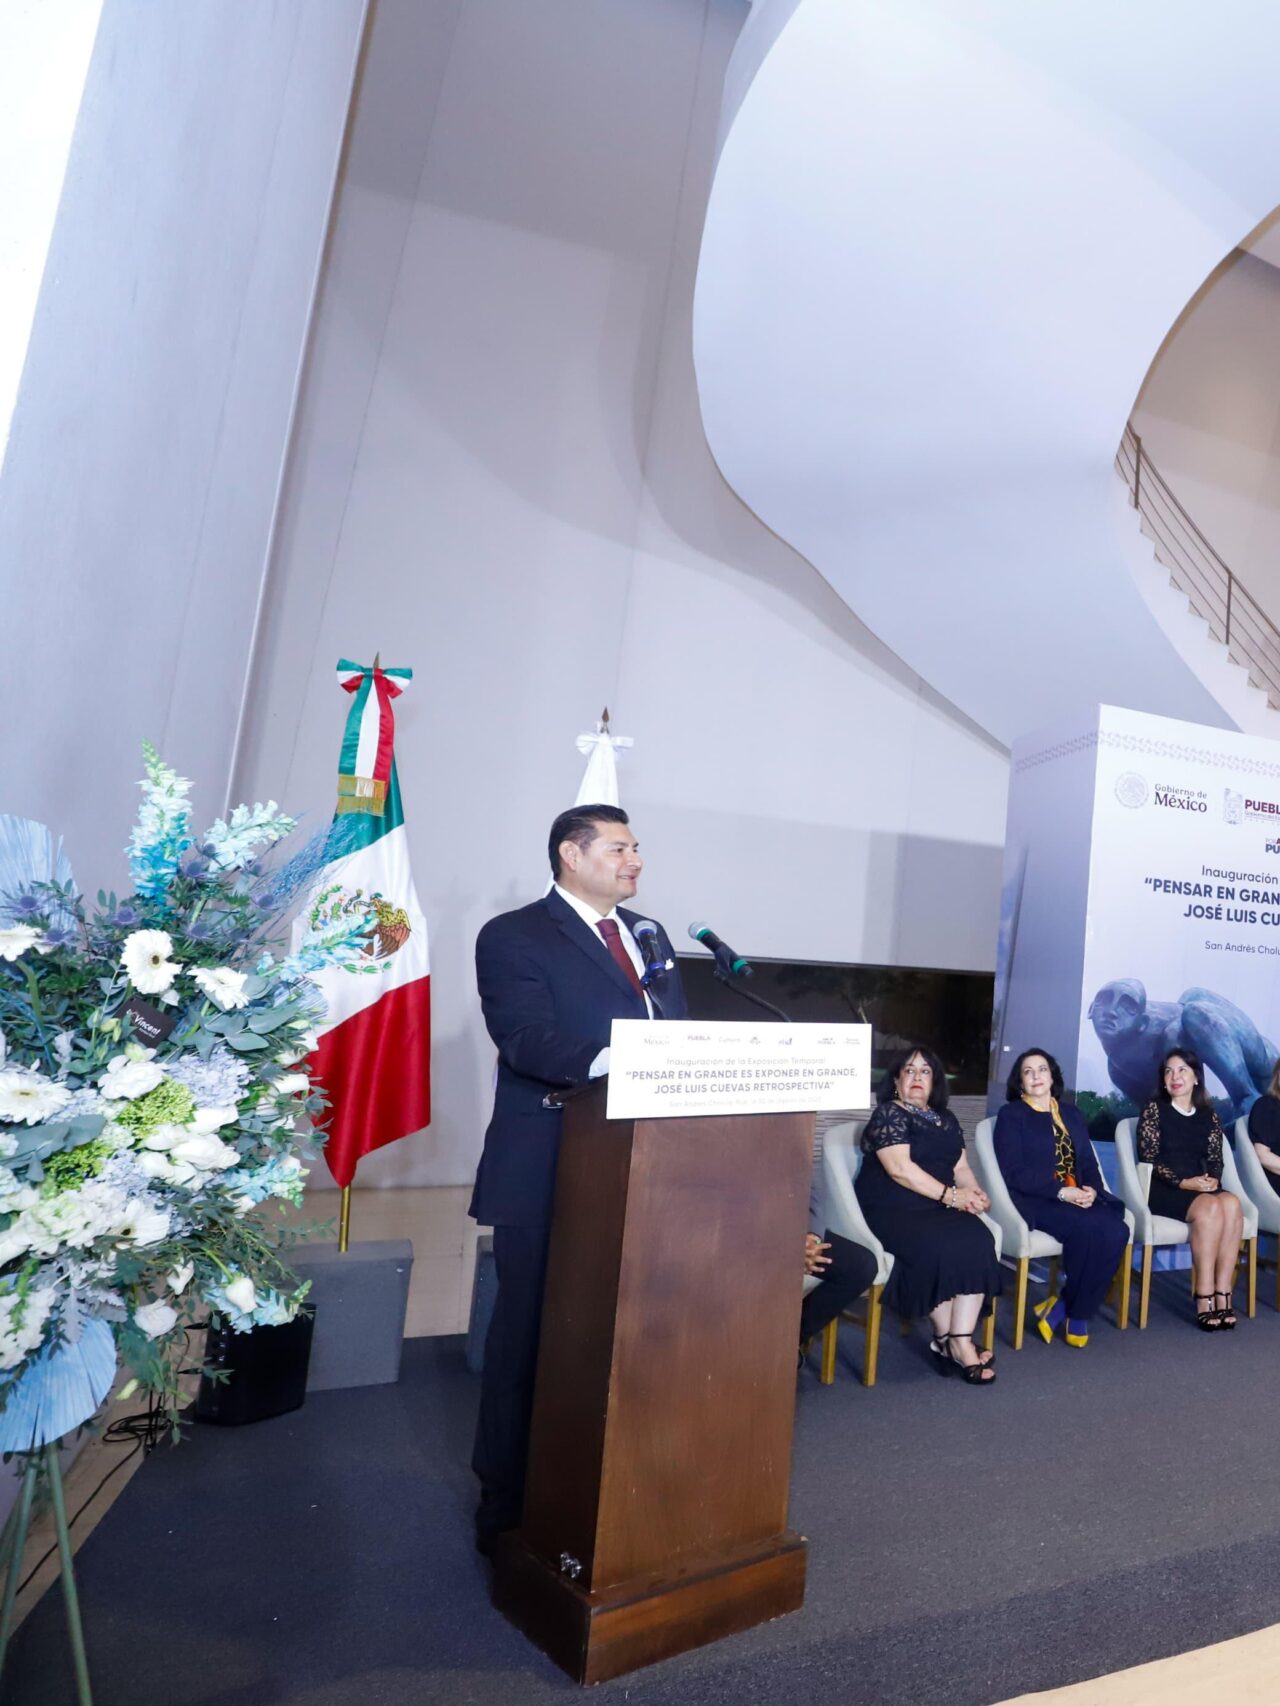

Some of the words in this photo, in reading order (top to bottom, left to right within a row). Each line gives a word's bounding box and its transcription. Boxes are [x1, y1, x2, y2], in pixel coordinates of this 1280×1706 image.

[1155, 784, 1195, 798] Gobierno
[1198, 790, 1208, 799] de
[1154, 792, 1208, 813] México
[1202, 865, 1278, 885] Inauguración
[1216, 886, 1235, 901] EN
[1184, 903, 1223, 921] JOSÉ
[1226, 908, 1257, 924] LUIS
[1205, 940, 1223, 951] San
[134, 1014, 161, 1036] Vincent
[666, 1057, 723, 1067] Inauguración
[725, 1057, 736, 1065] de
[678, 1070, 692, 1080] EN
[694, 1069, 738, 1079] GRANDE
[740, 1069, 753, 1078] ES
[755, 1068, 800, 1078] EXPONER
[802, 1068, 814, 1077] EN
[816, 1067, 858, 1078] GRANDE,
[654, 1082, 683, 1095] JOSÉ
[684, 1083, 708, 1094] LUIS
[710, 1082, 751, 1093] CUEVAS
